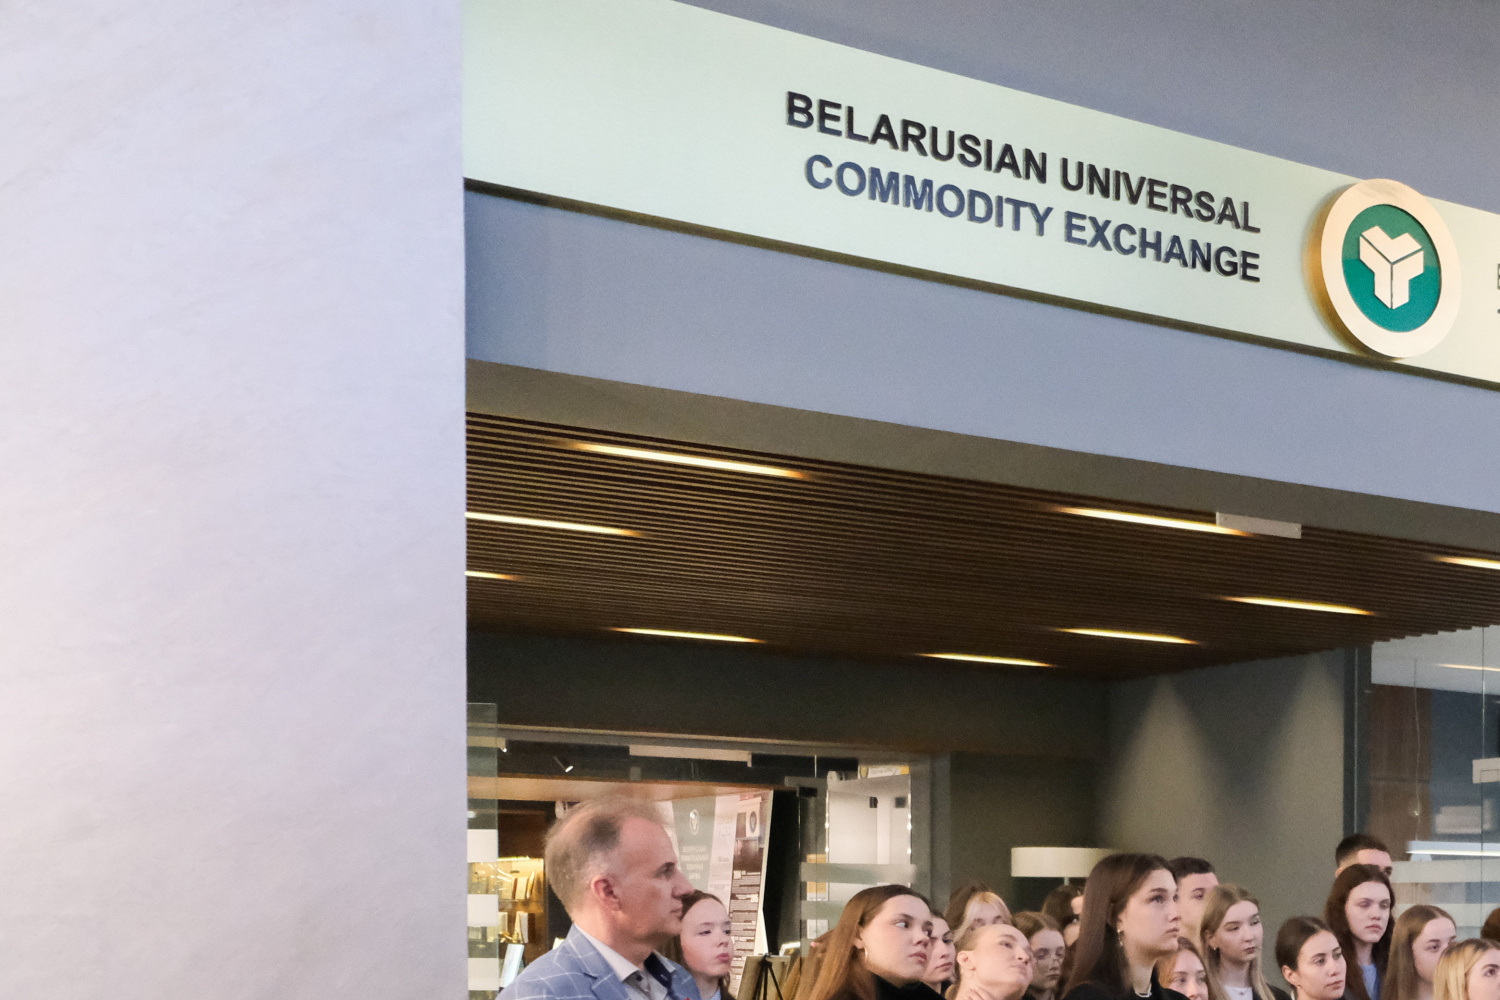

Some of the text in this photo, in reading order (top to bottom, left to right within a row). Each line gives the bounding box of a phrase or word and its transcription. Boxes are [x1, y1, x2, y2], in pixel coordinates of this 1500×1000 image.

[785, 91, 1261, 233] BELARUSIAN UNIVERSAL
[804, 154, 1261, 282] COMMODITY EXCHANGE
